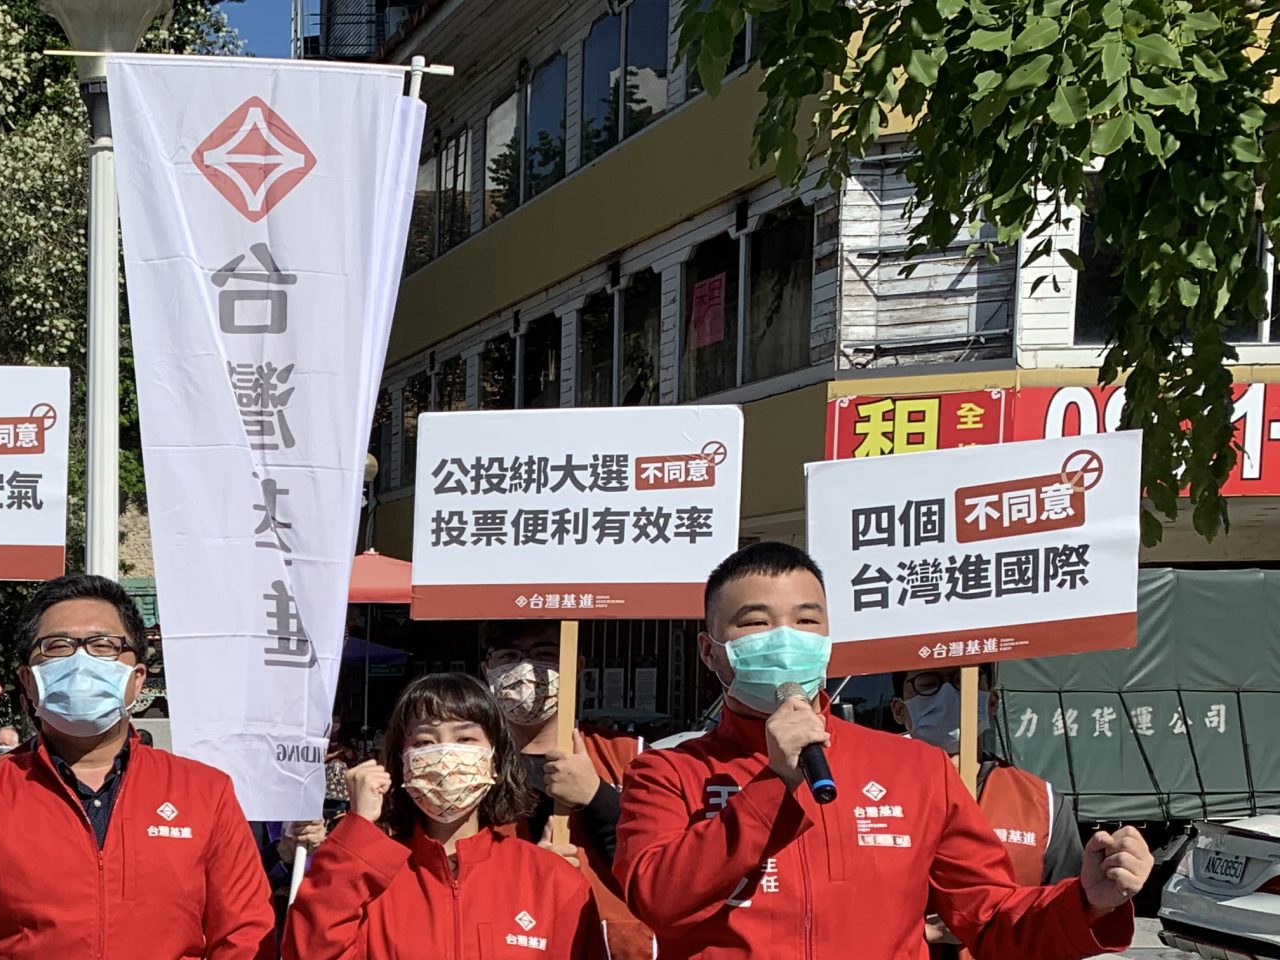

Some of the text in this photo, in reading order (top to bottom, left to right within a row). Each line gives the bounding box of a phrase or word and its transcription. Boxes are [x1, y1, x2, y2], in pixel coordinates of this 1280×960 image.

[955, 402, 985, 430] 全
[431, 453, 709, 496] 公投綁大選 不同意
[431, 505, 713, 547] 投票便利有效率
[851, 482, 1076, 551] 四個 不同意
[850, 543, 1090, 612] 台灣進國際
[529, 593, 595, 609] 台灣基進
[932, 637, 999, 659] 台灣基進
[1014, 703, 1227, 738] 力銘貨運公司
